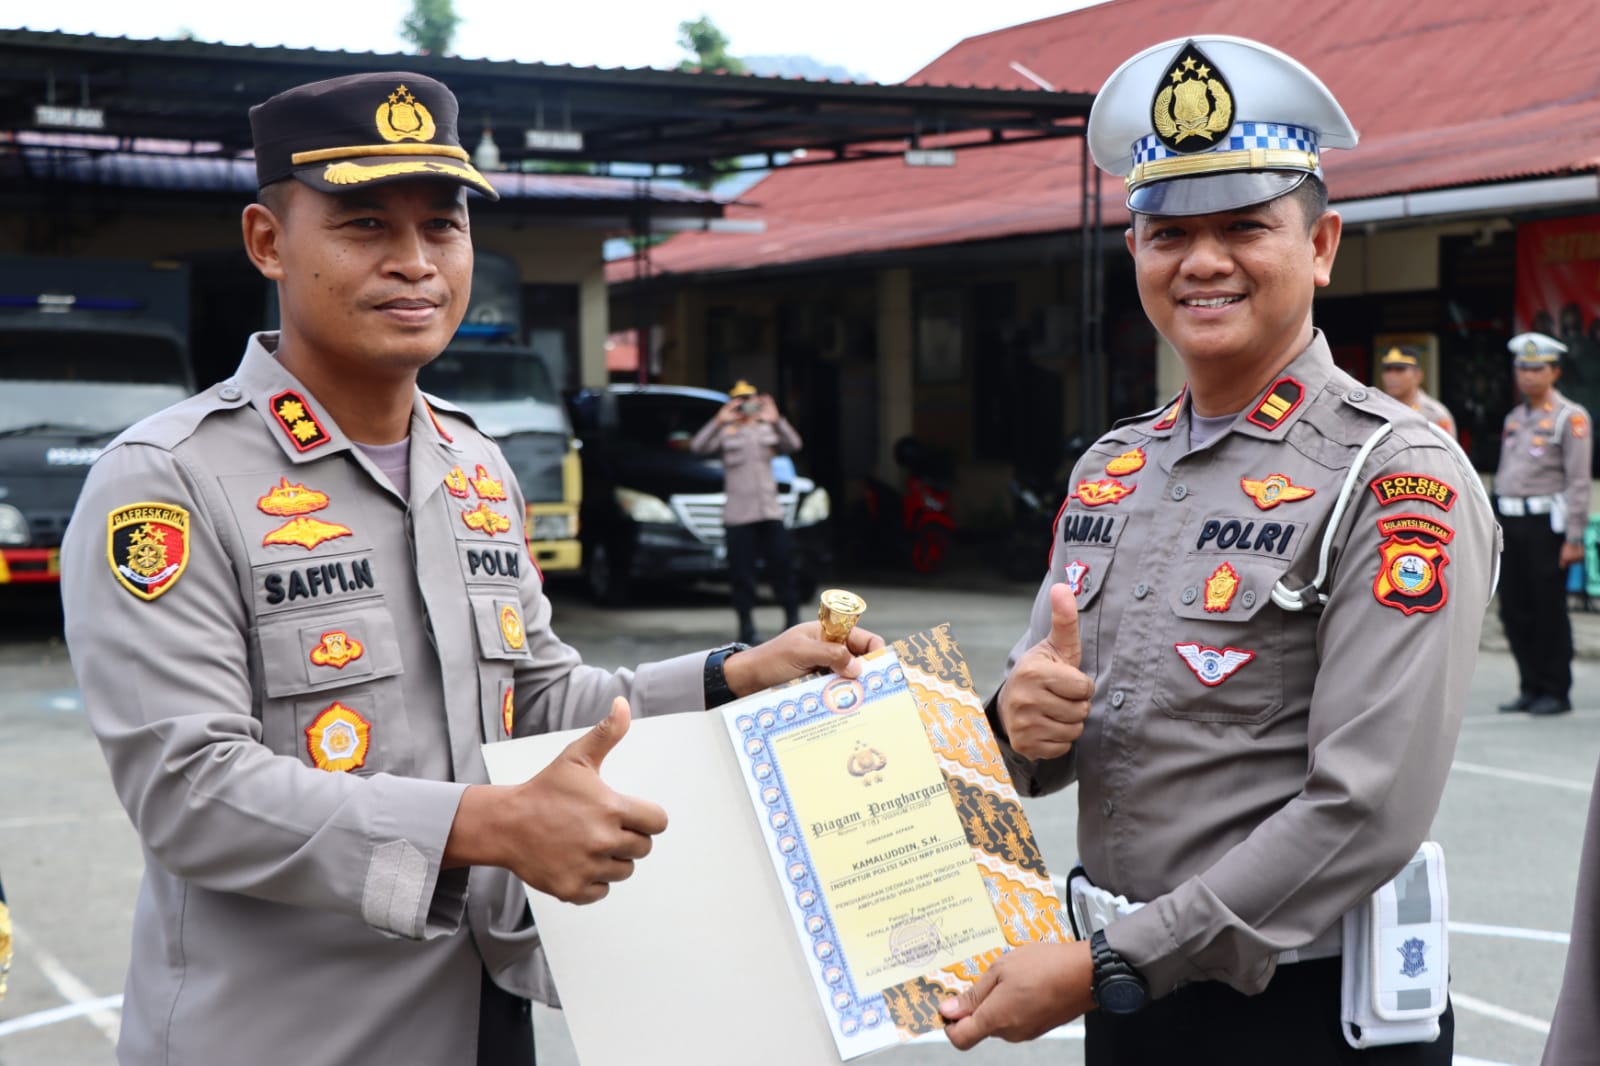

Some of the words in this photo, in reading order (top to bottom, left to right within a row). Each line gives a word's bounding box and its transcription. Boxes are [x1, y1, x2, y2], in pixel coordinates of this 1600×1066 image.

[46, 447, 102, 465] ISUZ
[1382, 477, 1448, 496] POLRES
[1386, 486, 1447, 502] PALOPO
[1196, 519, 1295, 555] POLRI
[1383, 519, 1418, 530] SULAWESI
[1419, 519, 1448, 538] SELATAN
[467, 549, 519, 578] POLRI
[812, 812, 861, 838] Piagam
[853, 843, 920, 871] KAMALUDDIN,
[921, 835, 941, 847] S.H.
[831, 873, 872, 892] INSPEKTUR
[873, 863, 898, 876] POLISI
[899, 856, 918, 867] SATU
[919, 851, 934, 859] NRP
[933, 870, 961, 884] MEDSOS
[836, 890, 884, 909] PENGHARGAAN
[885, 879, 915, 892] DEDIKASI
[916, 872, 933, 881] YANG
[934, 864, 956, 875] TINGGI
